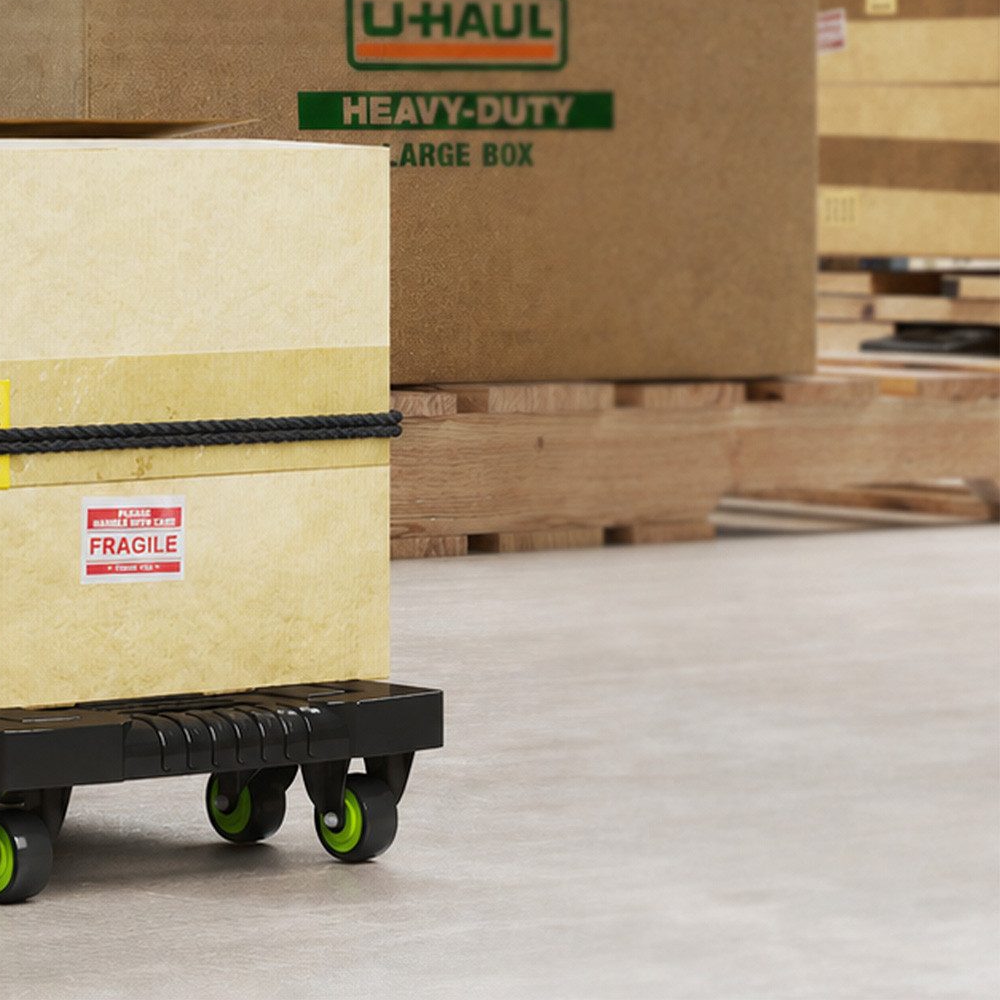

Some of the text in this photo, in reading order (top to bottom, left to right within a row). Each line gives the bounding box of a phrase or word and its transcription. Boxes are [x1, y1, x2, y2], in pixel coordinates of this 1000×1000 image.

[343, 96, 575, 125] HEAVY-DUTY
[482, 142, 535, 168] BOX
[90, 535, 177, 555] FRAGILE
